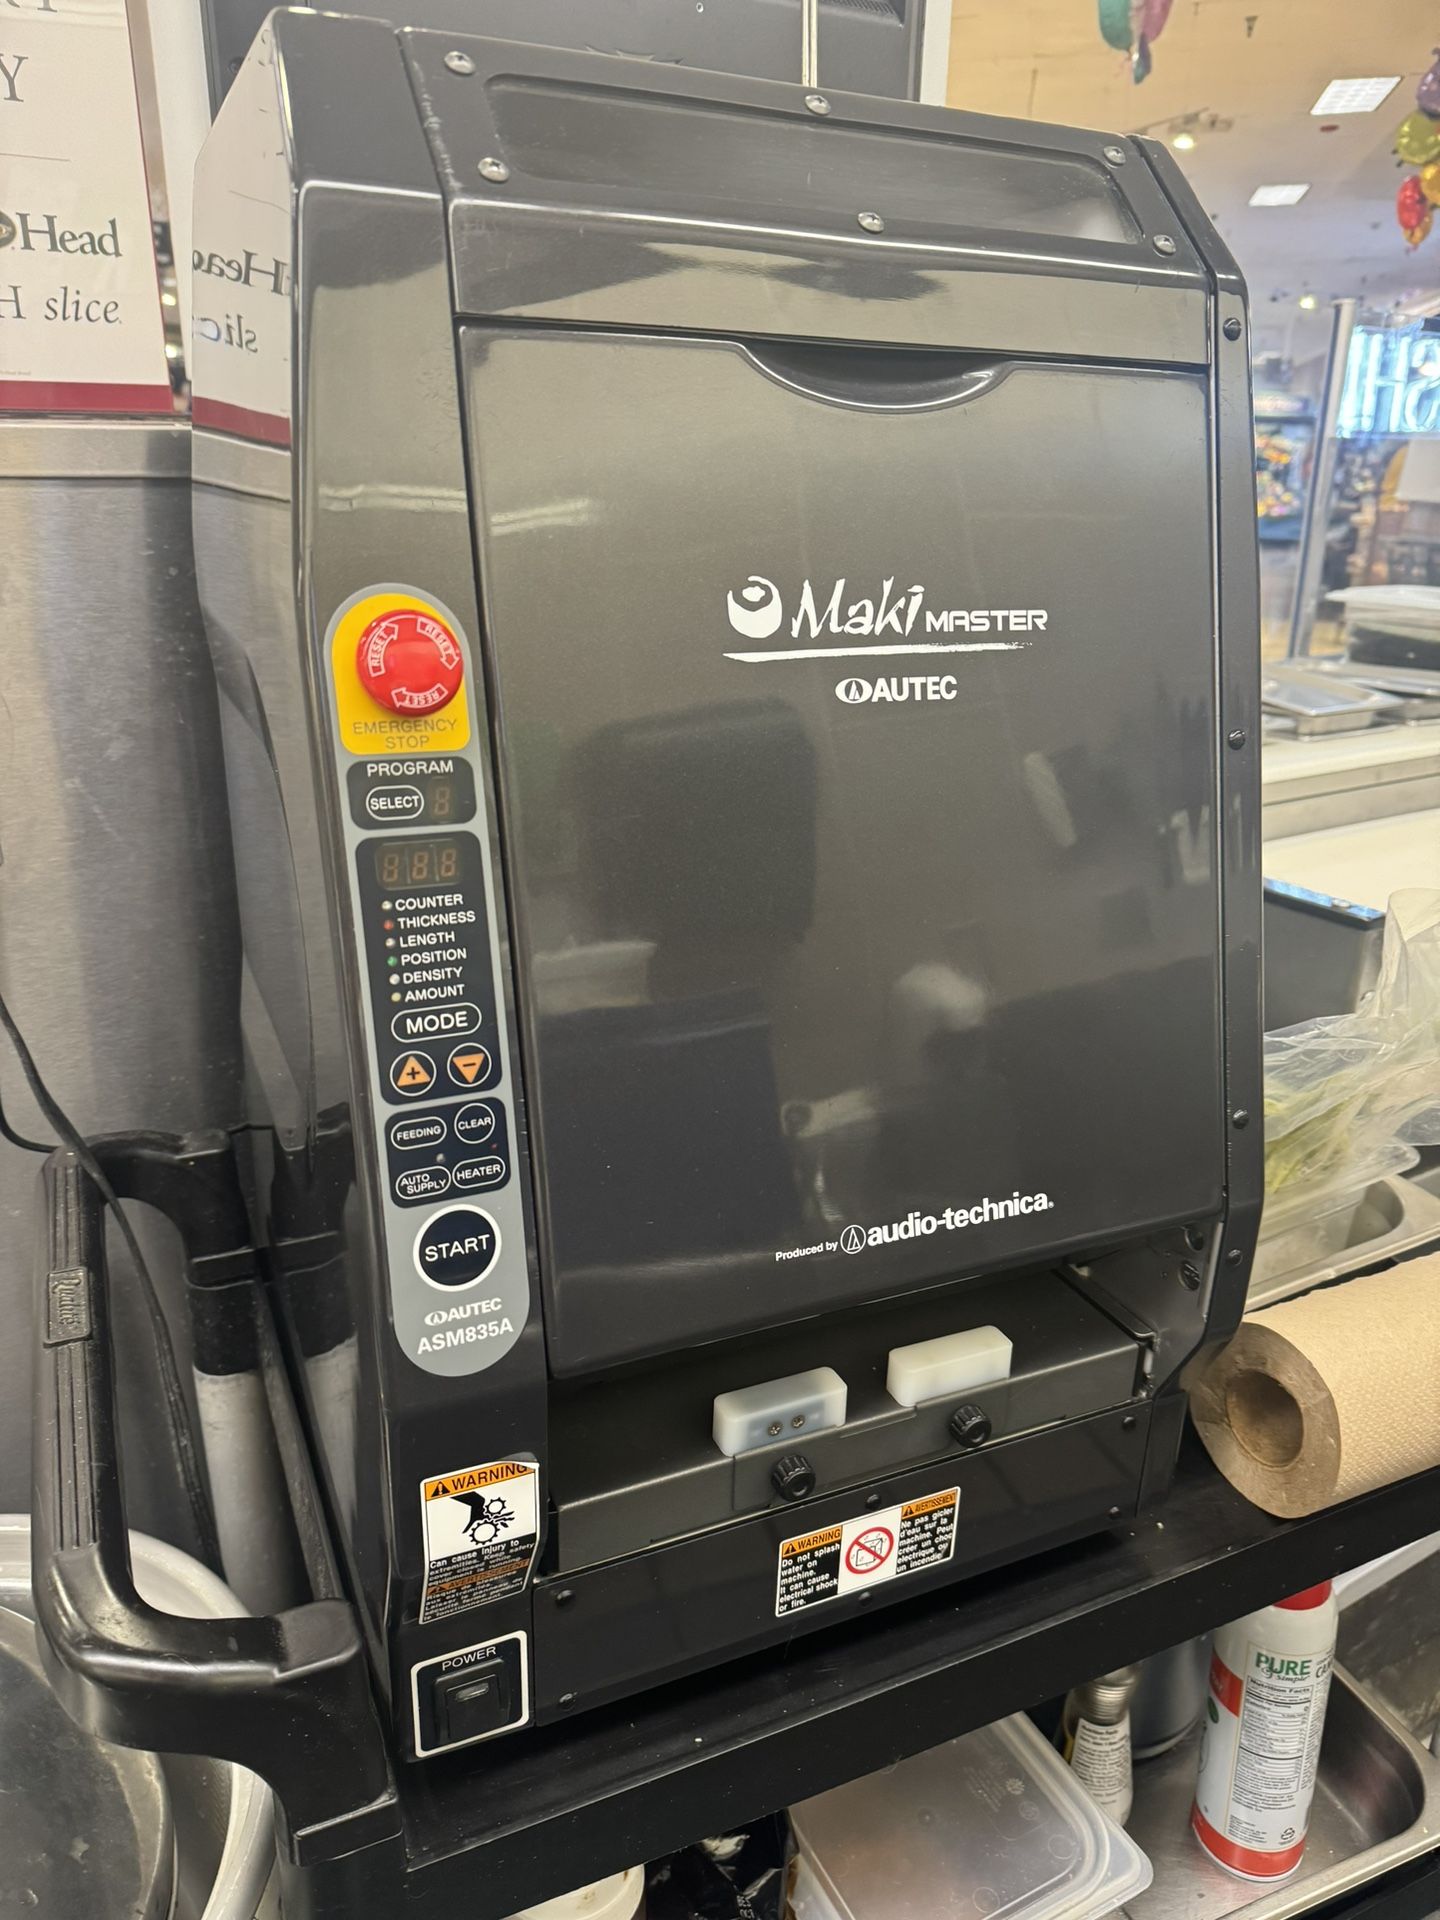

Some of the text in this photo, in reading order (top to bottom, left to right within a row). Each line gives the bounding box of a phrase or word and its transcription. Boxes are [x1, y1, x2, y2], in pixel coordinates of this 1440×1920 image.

[15, 212, 122, 258] Head
[790, 576, 1048, 639] Maki MASTER
[871, 675, 957, 702] AUTEC
[353, 718, 457, 735] EMERGENCY
[385, 735, 430, 750] STOP
[367, 760, 454, 777] PROGRAM
[370, 795, 419, 810] SELECT
[395, 894, 464, 911] COUNTER
[398, 911, 476, 929] THICKNESS
[399, 931, 456, 948] LENGTH
[401, 948, 467, 966] POSITION
[403, 966, 463, 984] DENSITY
[404, 984, 465, 1002] AMOUNT
[406, 1011, 468, 1034] MODE
[458, 1117, 492, 1130] CLEAR
[397, 1125, 441, 1142] FEEDING
[401, 1173, 430, 1186] AUTO
[456, 1164, 501, 1180] HEATER
[407, 1179, 446, 1194] SUPPLY
[425, 1234, 490, 1262] START
[775, 1243, 823, 1261] Produced
[826, 1240, 838, 1252] by
[447, 1298, 502, 1321] AUTEC
[417, 1317, 513, 1354] ASM835A
[451, 1463, 528, 1490] WARNING
[901, 1507, 954, 1529] Ne pas gicler
[900, 1517, 948, 1538] d'eau sur la
[936, 1523, 953, 1535] Peut
[798, 1529, 841, 1549] WARNING
[921, 1540, 932, 1548] un
[934, 1532, 953, 1543] choc
[430, 1560, 448, 1569] Can
[452, 1552, 477, 1563] cause
[481, 1543, 506, 1555] injury
[782, 1543, 840, 1568] Do not splash
[781, 1560, 818, 1576] water on
[897, 1564, 907, 1573] un
[780, 1573, 830, 1595] It can cause
[781, 1569, 816, 1586] machine.
[780, 1586, 814, 1604] electrical
[779, 1598, 806, 1612] or fire.
[442, 1646, 497, 1671] POWER
[1256, 1652, 1313, 1675] PURE
